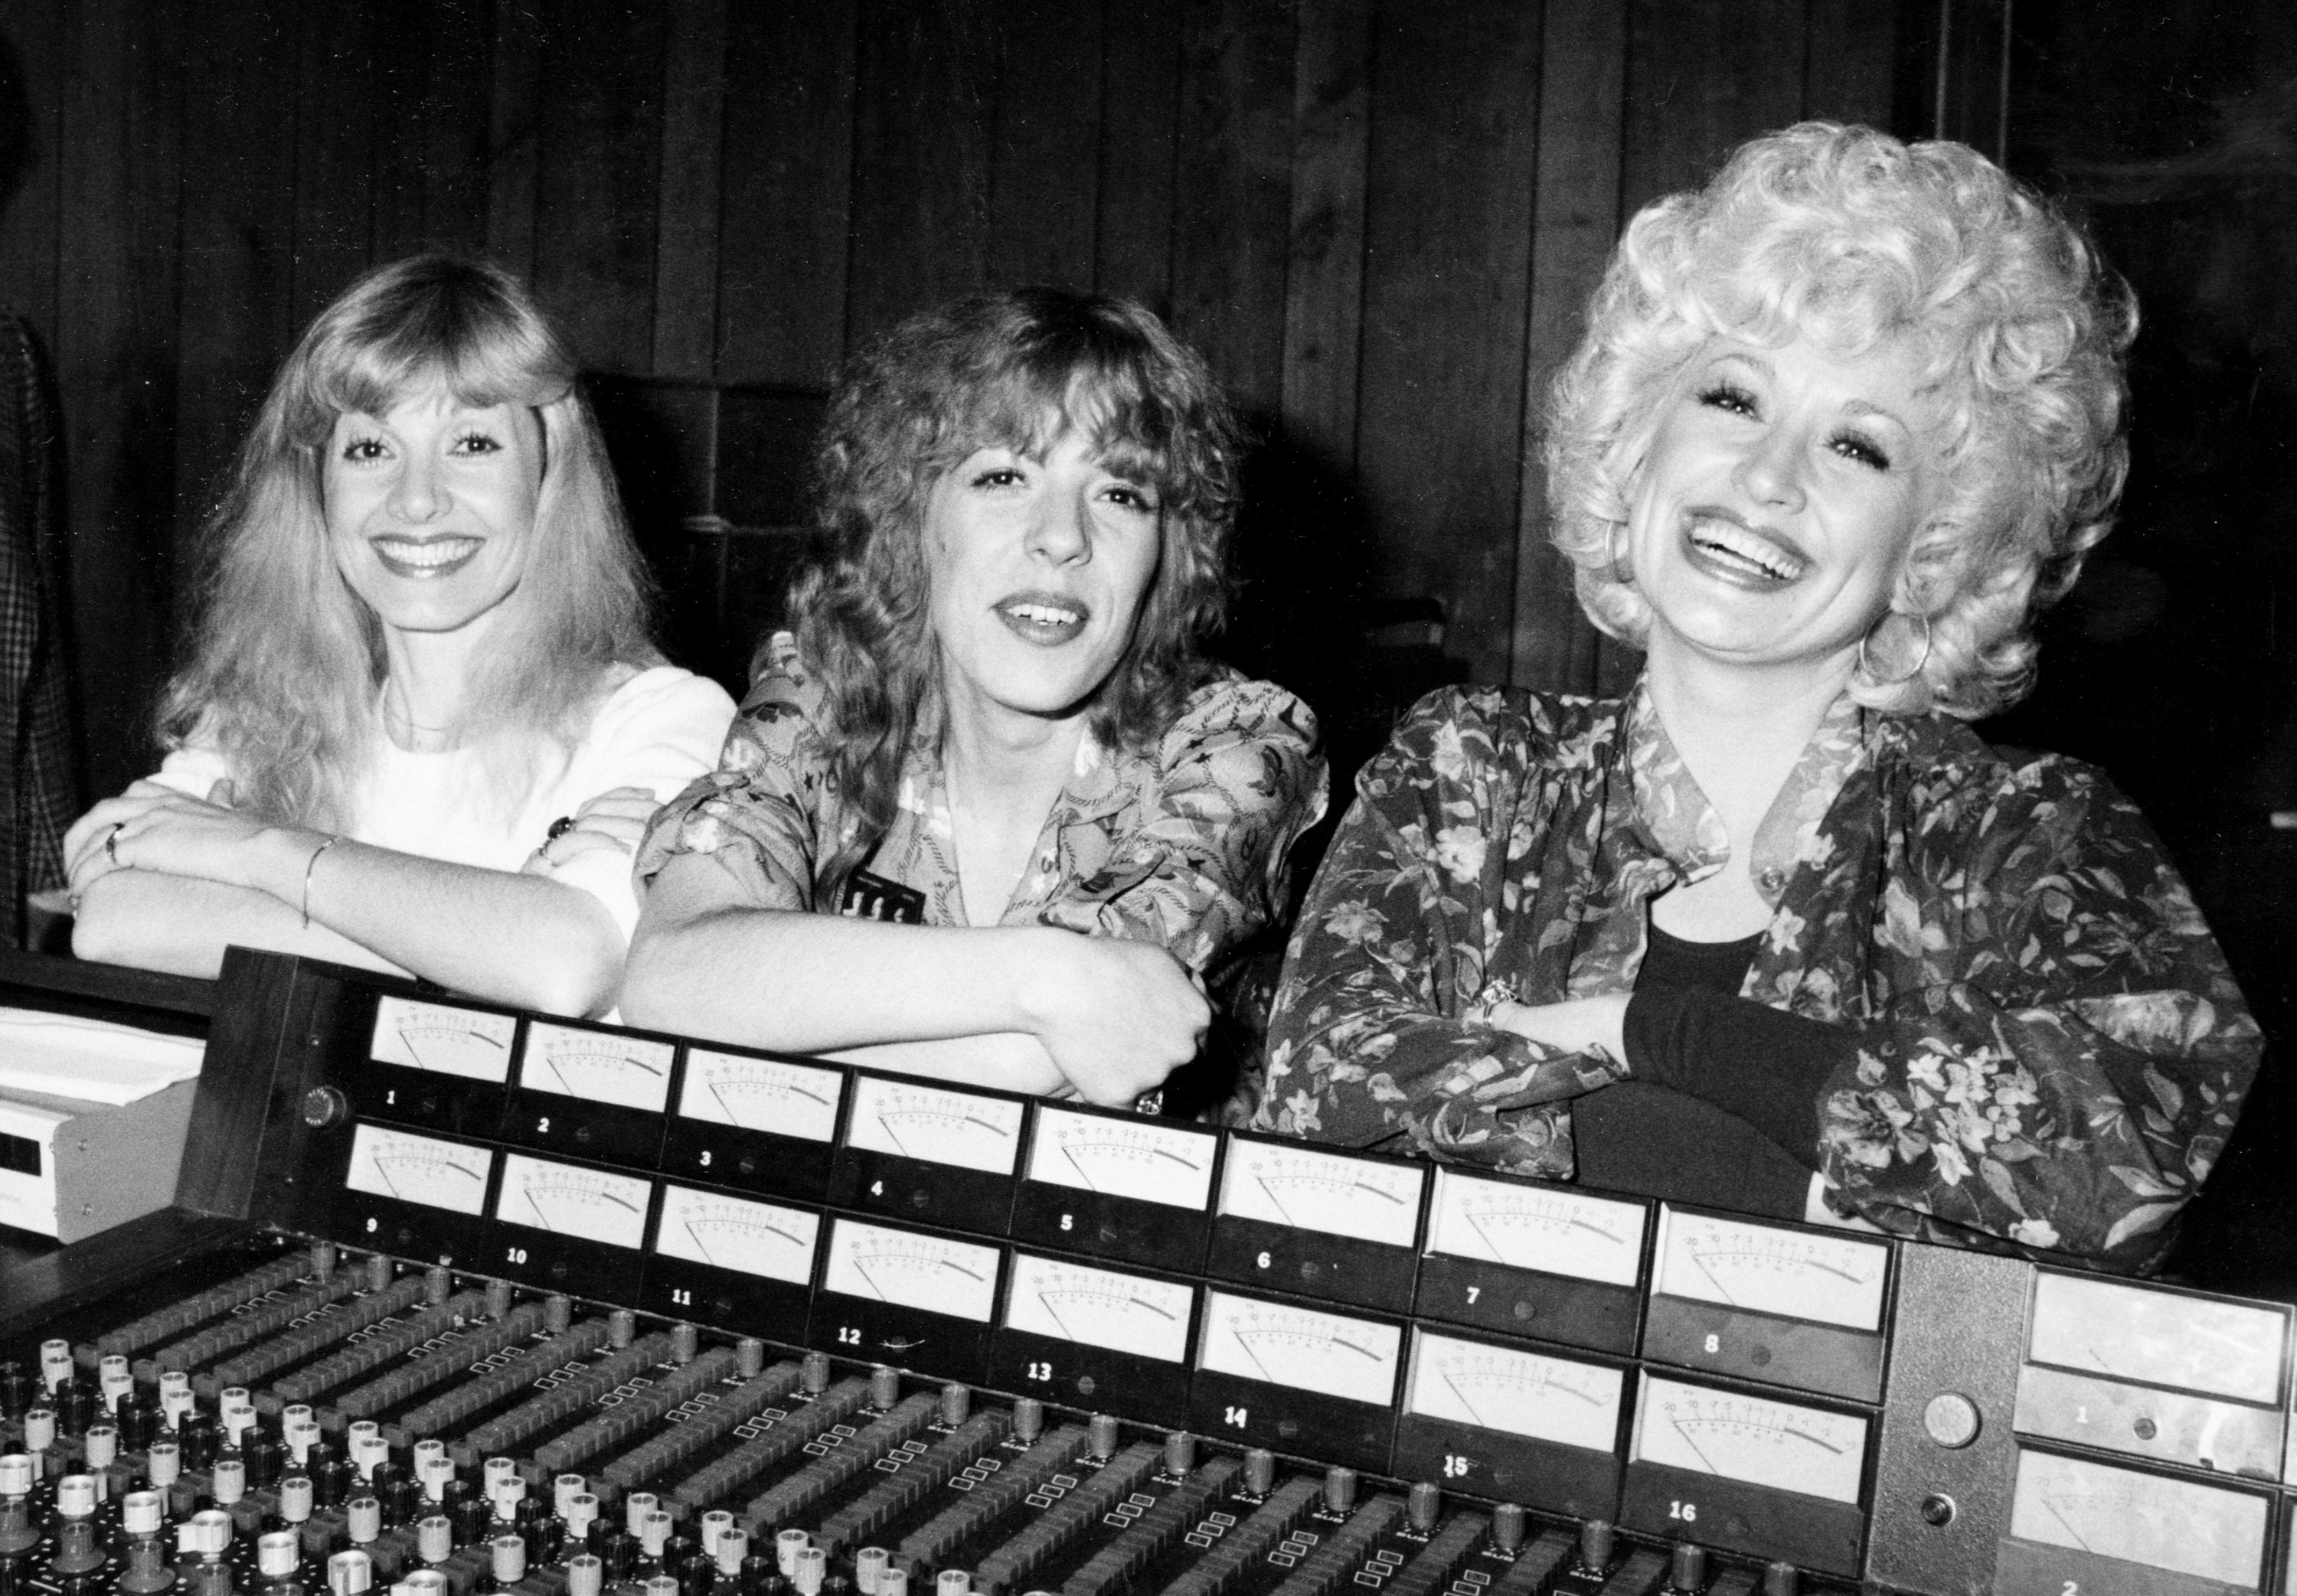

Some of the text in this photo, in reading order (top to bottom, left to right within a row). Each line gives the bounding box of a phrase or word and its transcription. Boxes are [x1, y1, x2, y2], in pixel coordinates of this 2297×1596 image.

[387, 1091, 394, 1104] 1
[538, 1118, 549, 1132] 2
[1155, 1136, 1162, 1144] 0
[701, 1151, 711, 1165] 3
[1357, 1169, 1364, 1177] 0
[871, 1181, 882, 1196] 4
[368, 1219, 377, 1232] 9
[1061, 1215, 1072, 1230] 5
[508, 1248, 527, 1264] 10
[1807, 1245, 1814, 1254] 0
[1258, 1252, 1270, 1268] 6
[1132, 1284, 1138, 1293] 0
[1468, 1287, 1479, 1304] 7
[673, 1289, 690, 1305] 11
[839, 1327, 861, 1344] 12
[1334, 1324, 1341, 1333] 0
[1705, 1334, 1718, 1353] 8
[1028, 1363, 1051, 1381] 13
[1225, 1407, 1247, 1428] 14
[1786, 1413, 1793, 1422] 0
[2077, 1406, 2087, 1423] 1
[1444, 1456, 1468, 1477] 15
[1670, 1501, 1695, 1521] 16
[2062, 1581, 2078, 1596] 2
